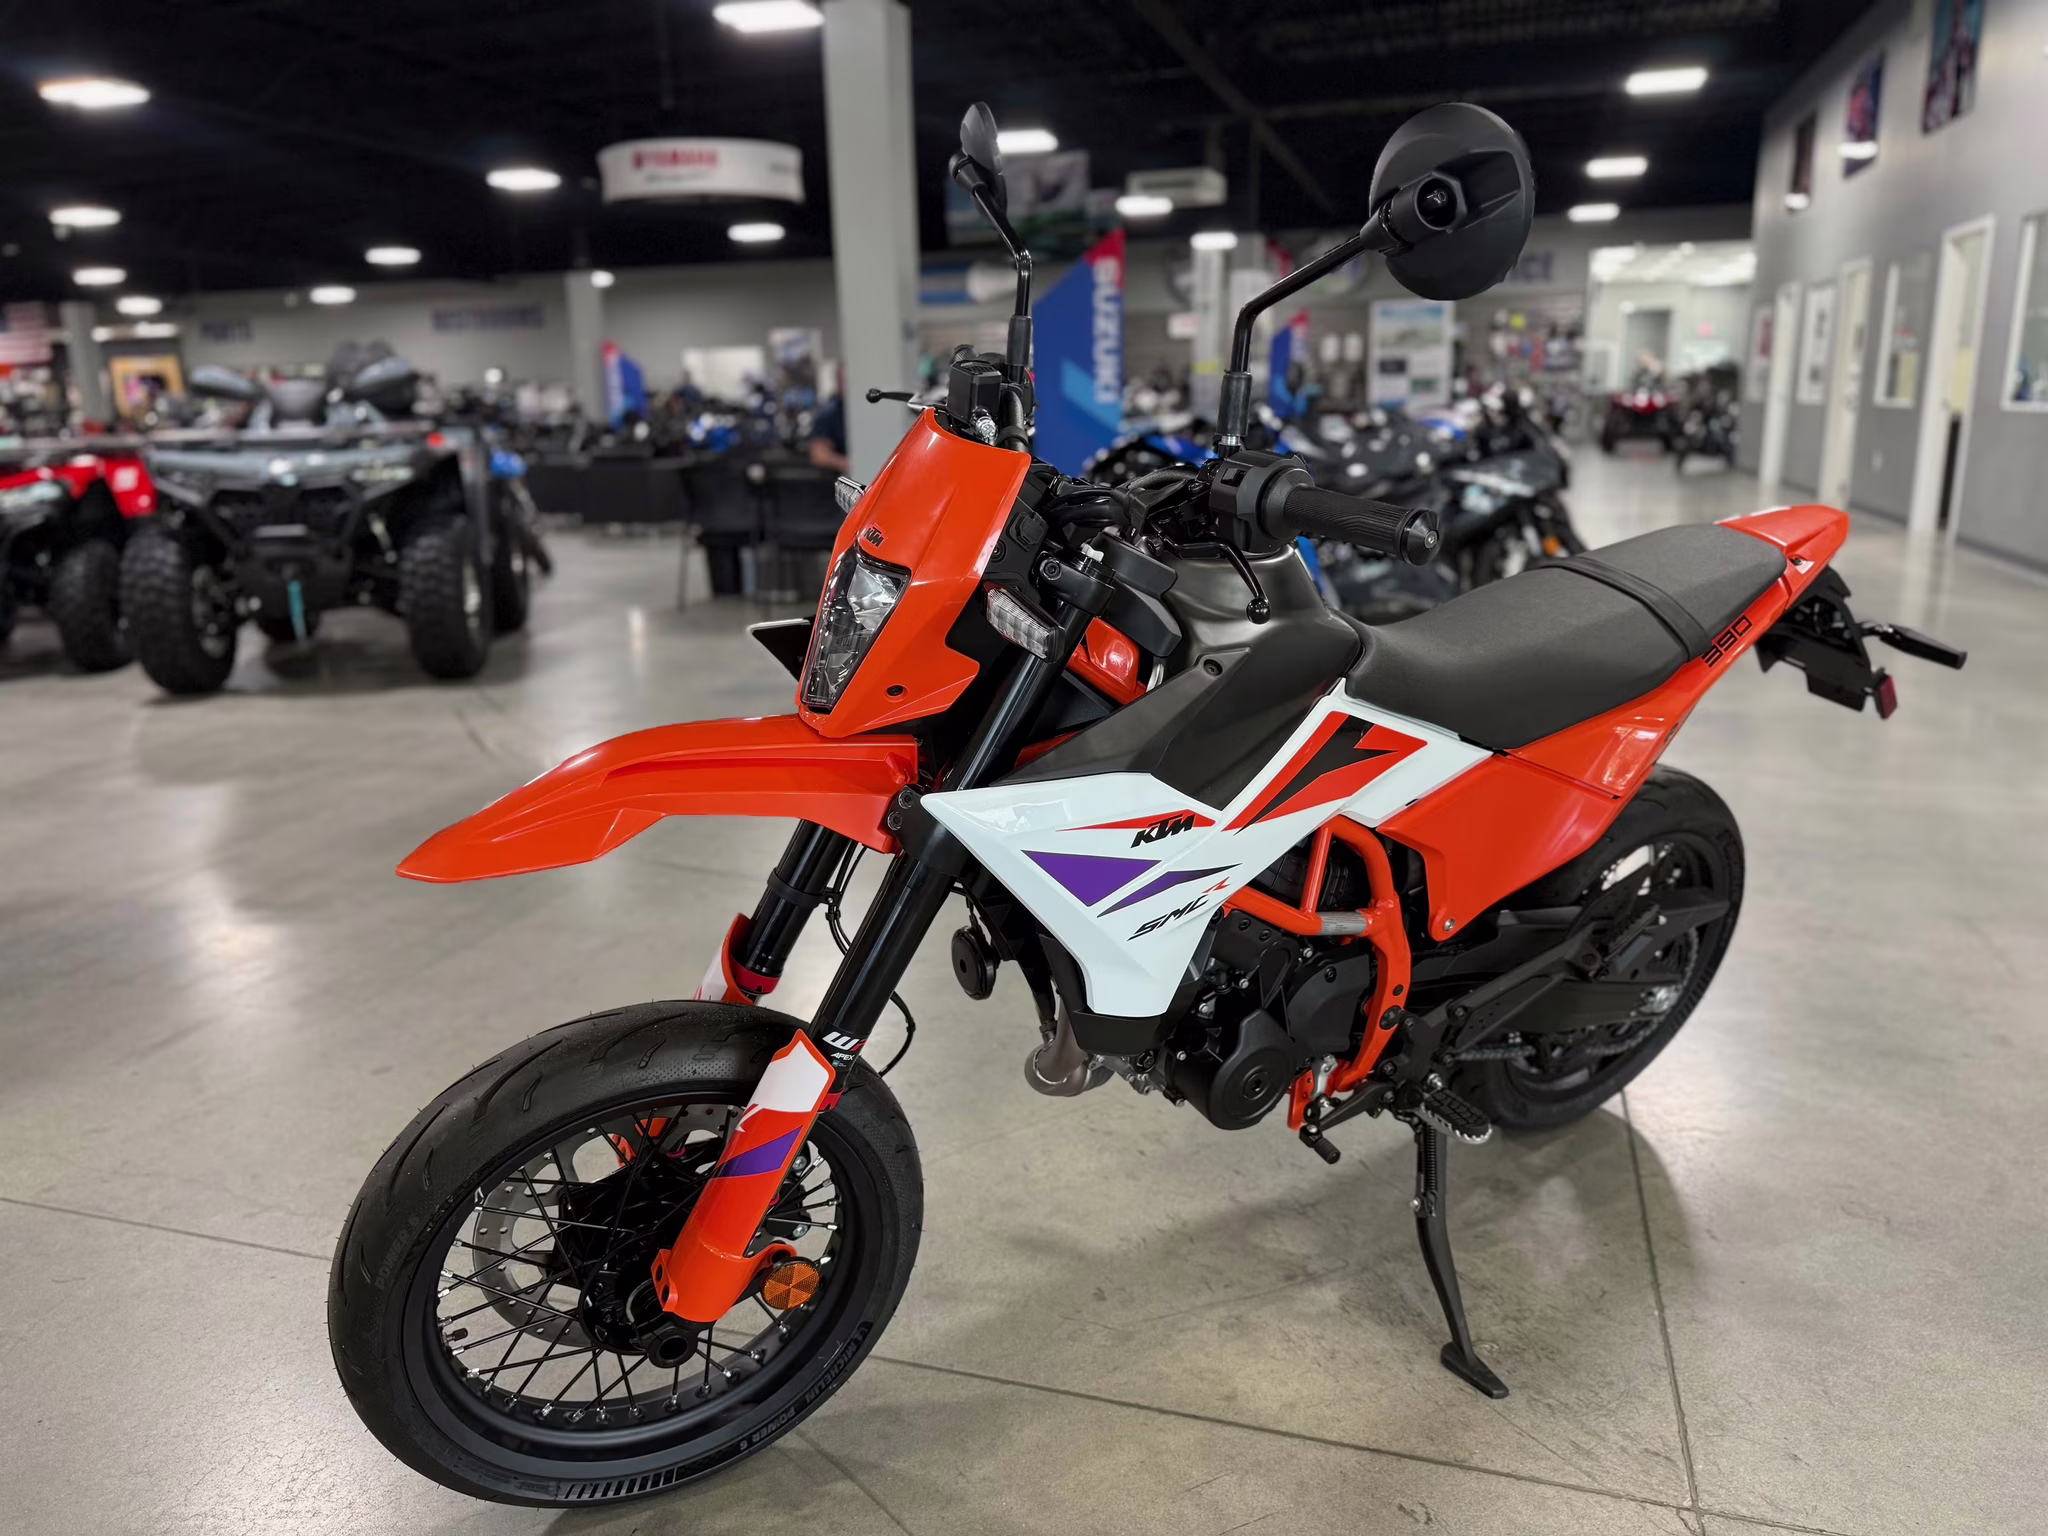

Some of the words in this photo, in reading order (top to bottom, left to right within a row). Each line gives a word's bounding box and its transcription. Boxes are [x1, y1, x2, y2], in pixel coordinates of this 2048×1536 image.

[1093, 256, 1121, 403] SUZUKI
[864, 526, 885, 547] KTM
[1701, 614, 1753, 668] 390
[1130, 814, 1195, 848] KTM
[1126, 894, 1209, 941] SMC
[831, 1052, 856, 1061] APEX
[804, 1340, 858, 1404] MICHELIN
[752, 1406, 797, 1443] POWER
[739, 1438, 750, 1451] 6
